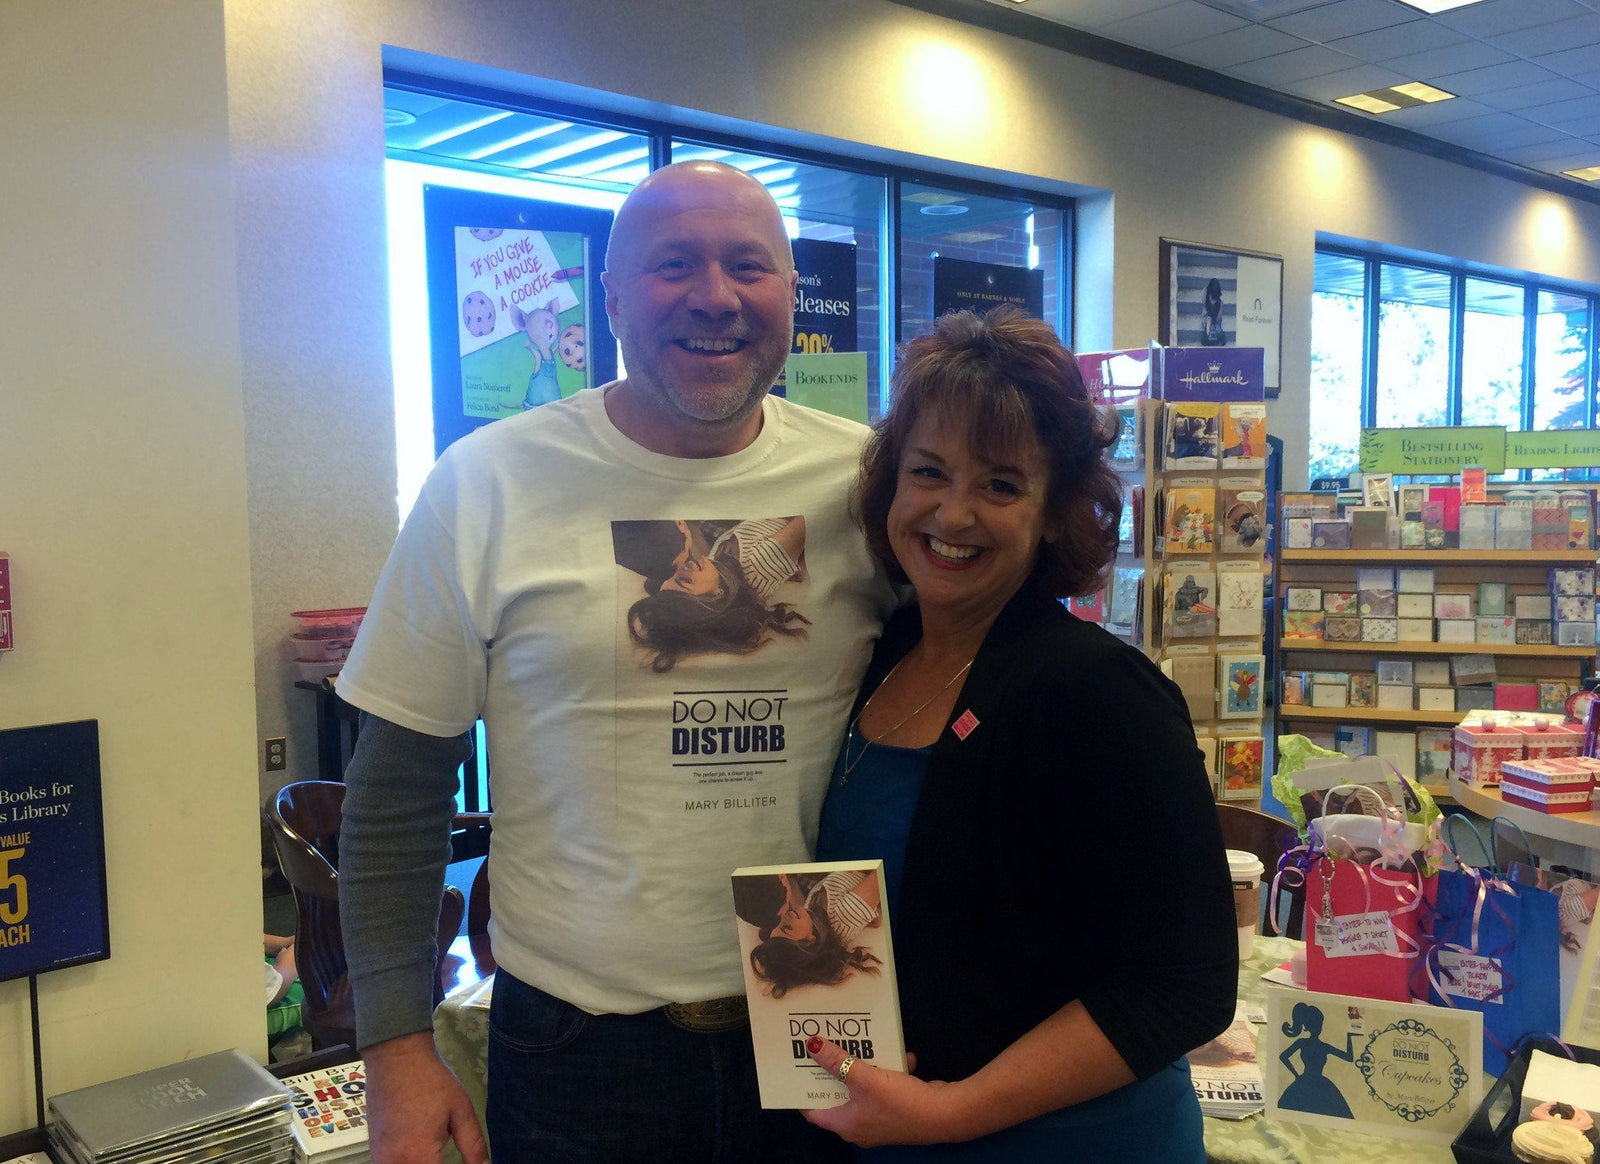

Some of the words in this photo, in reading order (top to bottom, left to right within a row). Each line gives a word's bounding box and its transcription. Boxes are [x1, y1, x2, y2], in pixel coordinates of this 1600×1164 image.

[470, 258, 482, 278] IF
[483, 247, 505, 271] YOU
[506, 236, 534, 260] GIVE
[494, 274, 502, 290] A
[503, 256, 543, 285] MOUSE
[500, 295, 508, 311] A
[511, 272, 552, 304] COOKIE
[796, 371, 858, 385] BOOKENDS
[1179, 369, 1249, 391] Hallmark
[1401, 439, 1484, 452] BESTSELLING
[1514, 444, 1560, 456] READING
[1402, 454, 1480, 465] STATIONERY
[1321, 480, 1341, 490] $9.95
[673, 699, 717, 724] DO
[725, 698, 788, 723] NOT
[672, 724, 786, 756] DISTURB
[0, 785, 47, 804] Books
[51, 782, 74, 797] for
[685, 800, 719, 811] MARY
[724, 796, 777, 809] BILLITER
[12, 802, 72, 822] Library
[0, 832, 31, 848] VALUE
[789, 1018, 820, 1036] DO
[825, 1018, 871, 1037] NOT
[1393, 1040, 1407, 1050] DO
[1409, 1040, 1431, 1052] NOT
[1393, 1048, 1430, 1061] DISTURB
[282, 1073, 316, 1086] Bill
[1379, 1061, 1443, 1086] Cupcakes
[1208, 1081, 1259, 1092] NOT
[807, 1091, 831, 1100] MARY
[1195, 1090, 1263, 1101] STURB
[304, 1113, 334, 1127] OF
